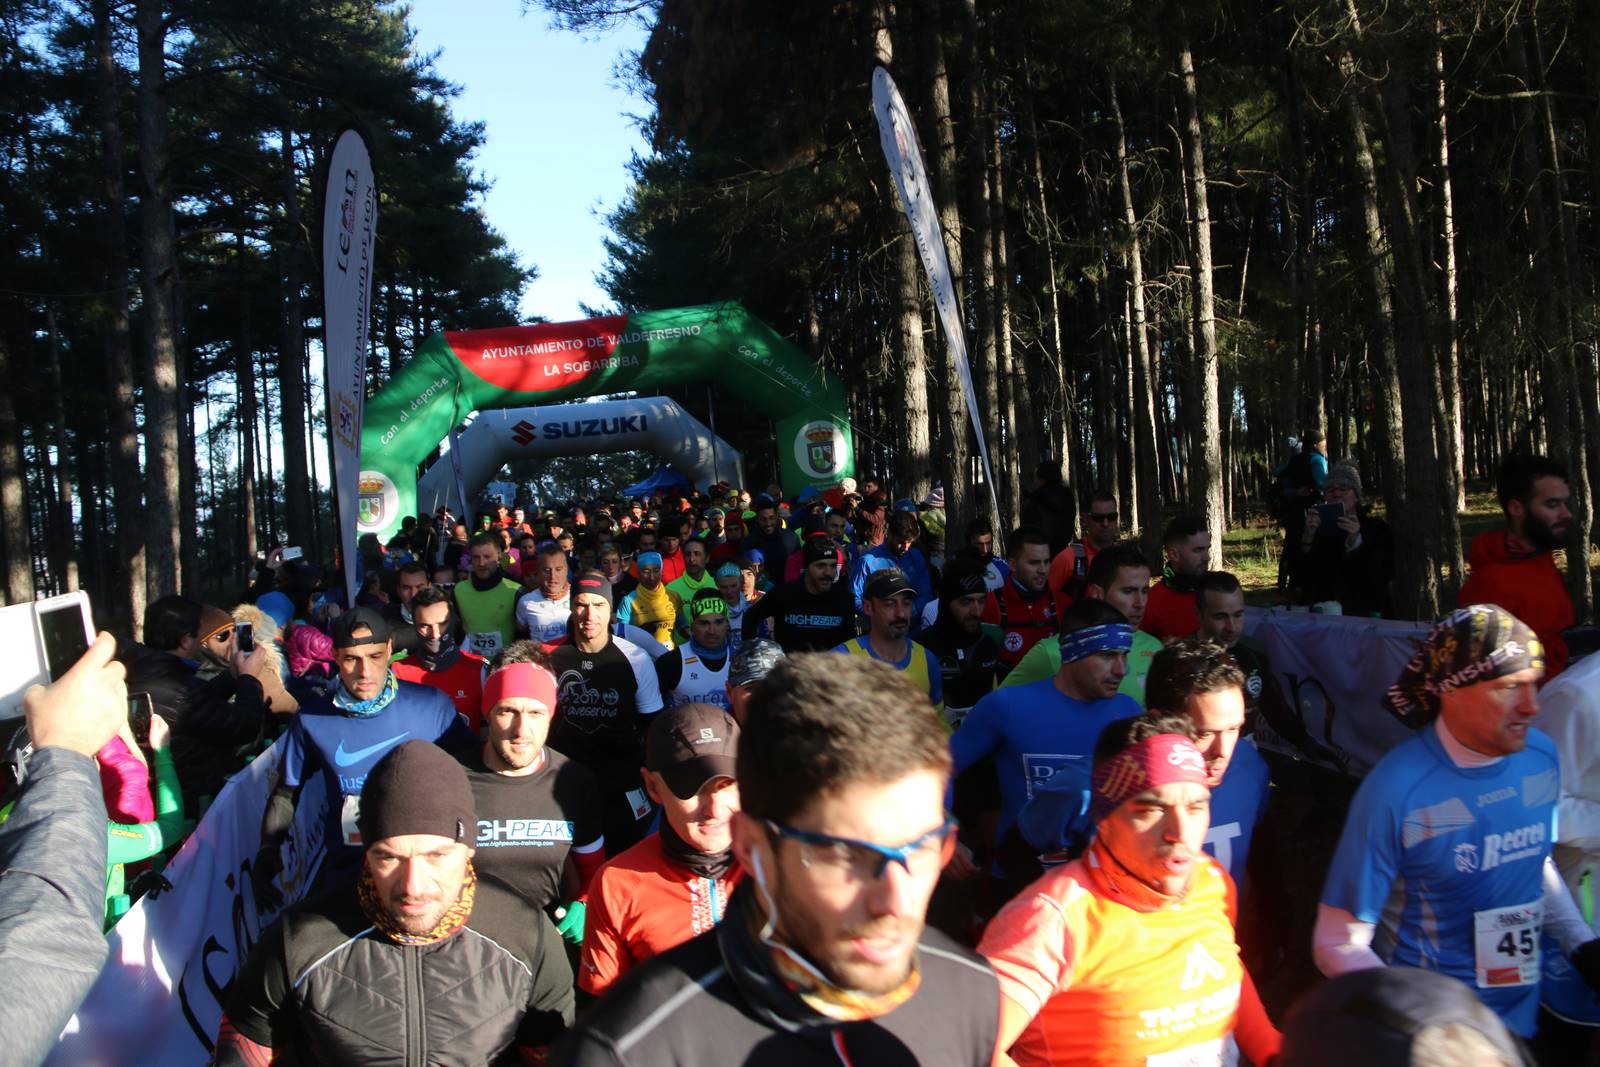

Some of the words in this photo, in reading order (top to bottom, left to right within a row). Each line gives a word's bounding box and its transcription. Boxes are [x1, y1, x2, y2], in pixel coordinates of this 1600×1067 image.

[353, 268, 367, 399] AYUNTAMIENTO
[361, 240, 368, 259] DE
[482, 338, 583, 360] AYUNTAMIENTO
[587, 336, 605, 348] DE
[608, 325, 701, 346] VALDEFRESNO
[544, 363, 560, 377] LA
[563, 355, 640, 374] SOBARRIBA
[737, 345, 758, 359] Con
[762, 359, 773, 367] el
[776, 365, 811, 397] deporte
[381, 425, 398, 445] Con
[400, 409, 409, 422] el
[410, 378, 449, 410] deporte
[542, 415, 648, 440] SUZUKI
[473, 637, 496, 649] 479
[1497, 926, 1540, 957] 45
